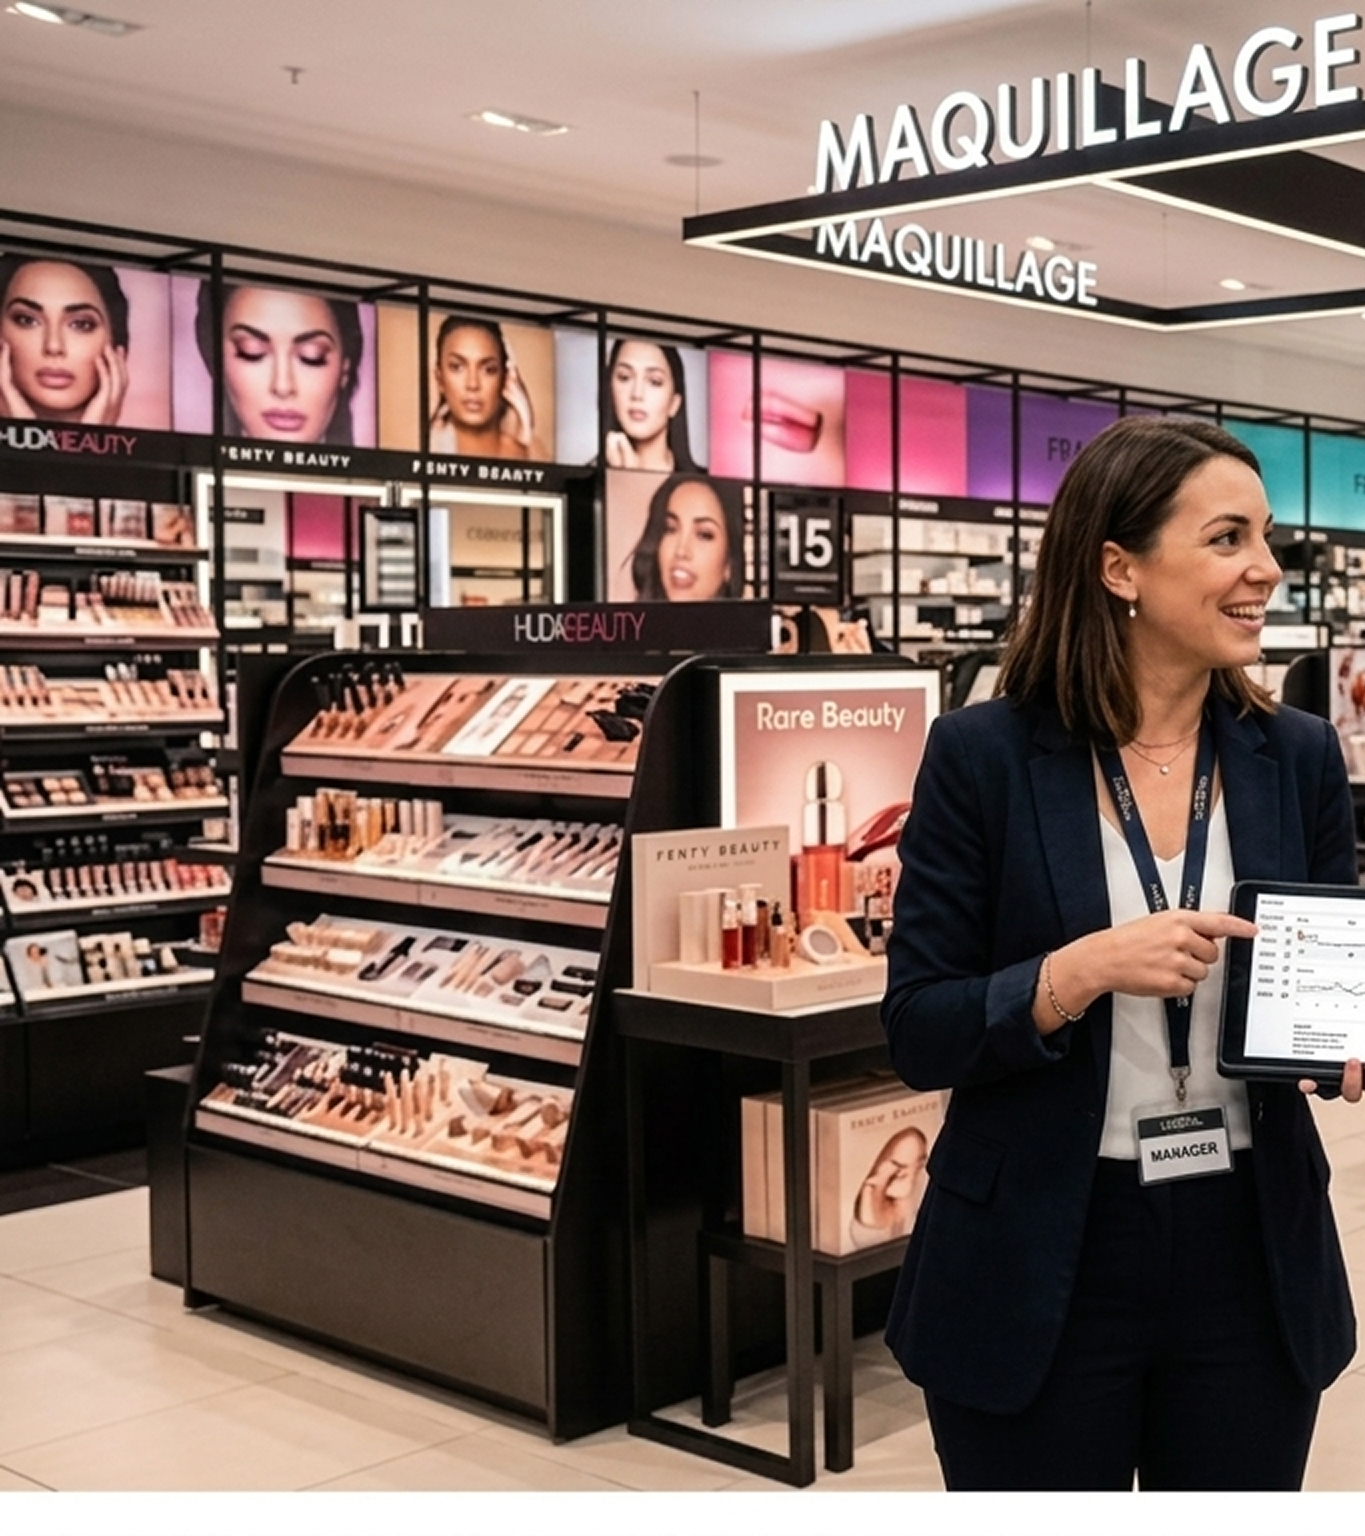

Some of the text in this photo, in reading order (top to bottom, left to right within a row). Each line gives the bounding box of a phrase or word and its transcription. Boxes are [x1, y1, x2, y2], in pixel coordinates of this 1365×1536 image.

[814, 12, 1361, 194] MAQUILLAGE
[815, 218, 1098, 306] MAQUILLAGE
[282, 450, 351, 468] BEAUTY
[778, 513, 833, 568] 15
[756, 700, 906, 733] Rare Beauty
[656, 840, 781, 862] FENTY BEAUTY
[1150, 1141, 1219, 1163] MANAGER
